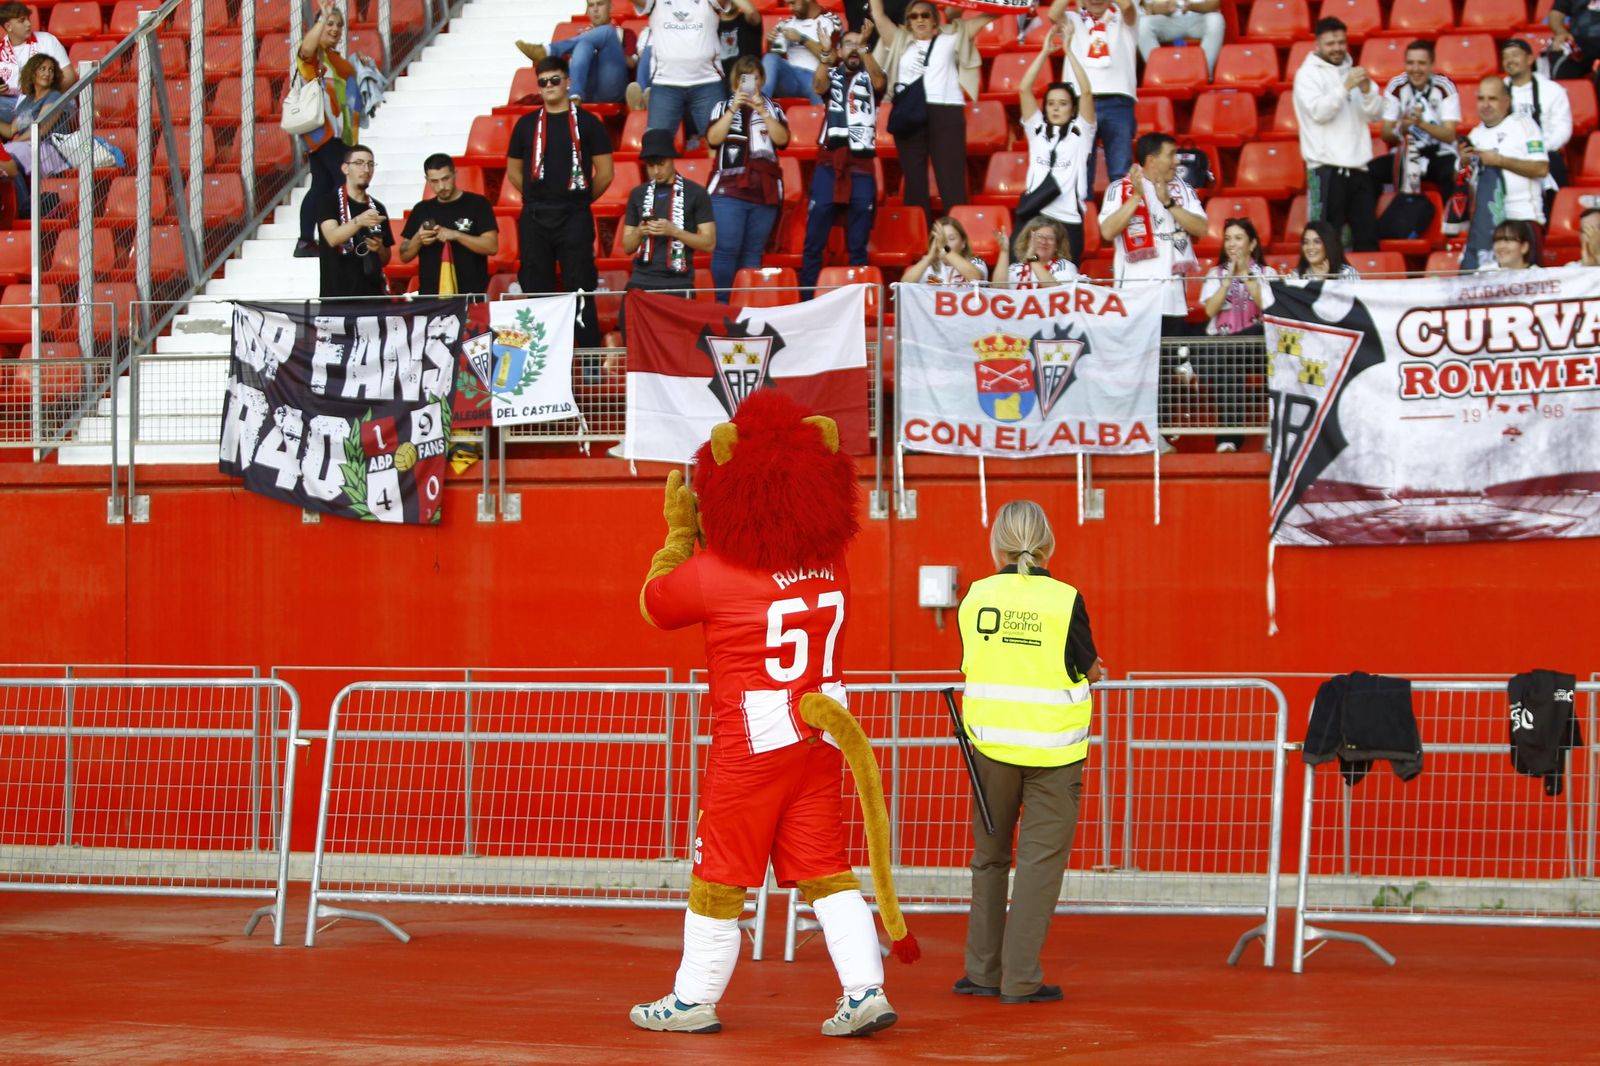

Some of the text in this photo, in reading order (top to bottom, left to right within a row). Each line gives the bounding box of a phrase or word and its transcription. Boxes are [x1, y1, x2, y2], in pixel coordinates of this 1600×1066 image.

[1458, 279, 1562, 300] ALBACETE
[934, 287, 1128, 320] BOGARRA
[311, 314, 461, 401] FANS
[1401, 356, 1600, 398] ROMME
[497, 408, 517, 419] DEL
[522, 402, 572, 417] CASTILLO
[1542, 404, 1565, 419] 98
[904, 418, 1152, 452] CON EL ALBA
[417, 437, 445, 460] FANS
[368, 453, 393, 472] ABP
[1002, 620, 1042, 632] control
[1004, 610, 1039, 622] grupo
[764, 590, 845, 682] 57
